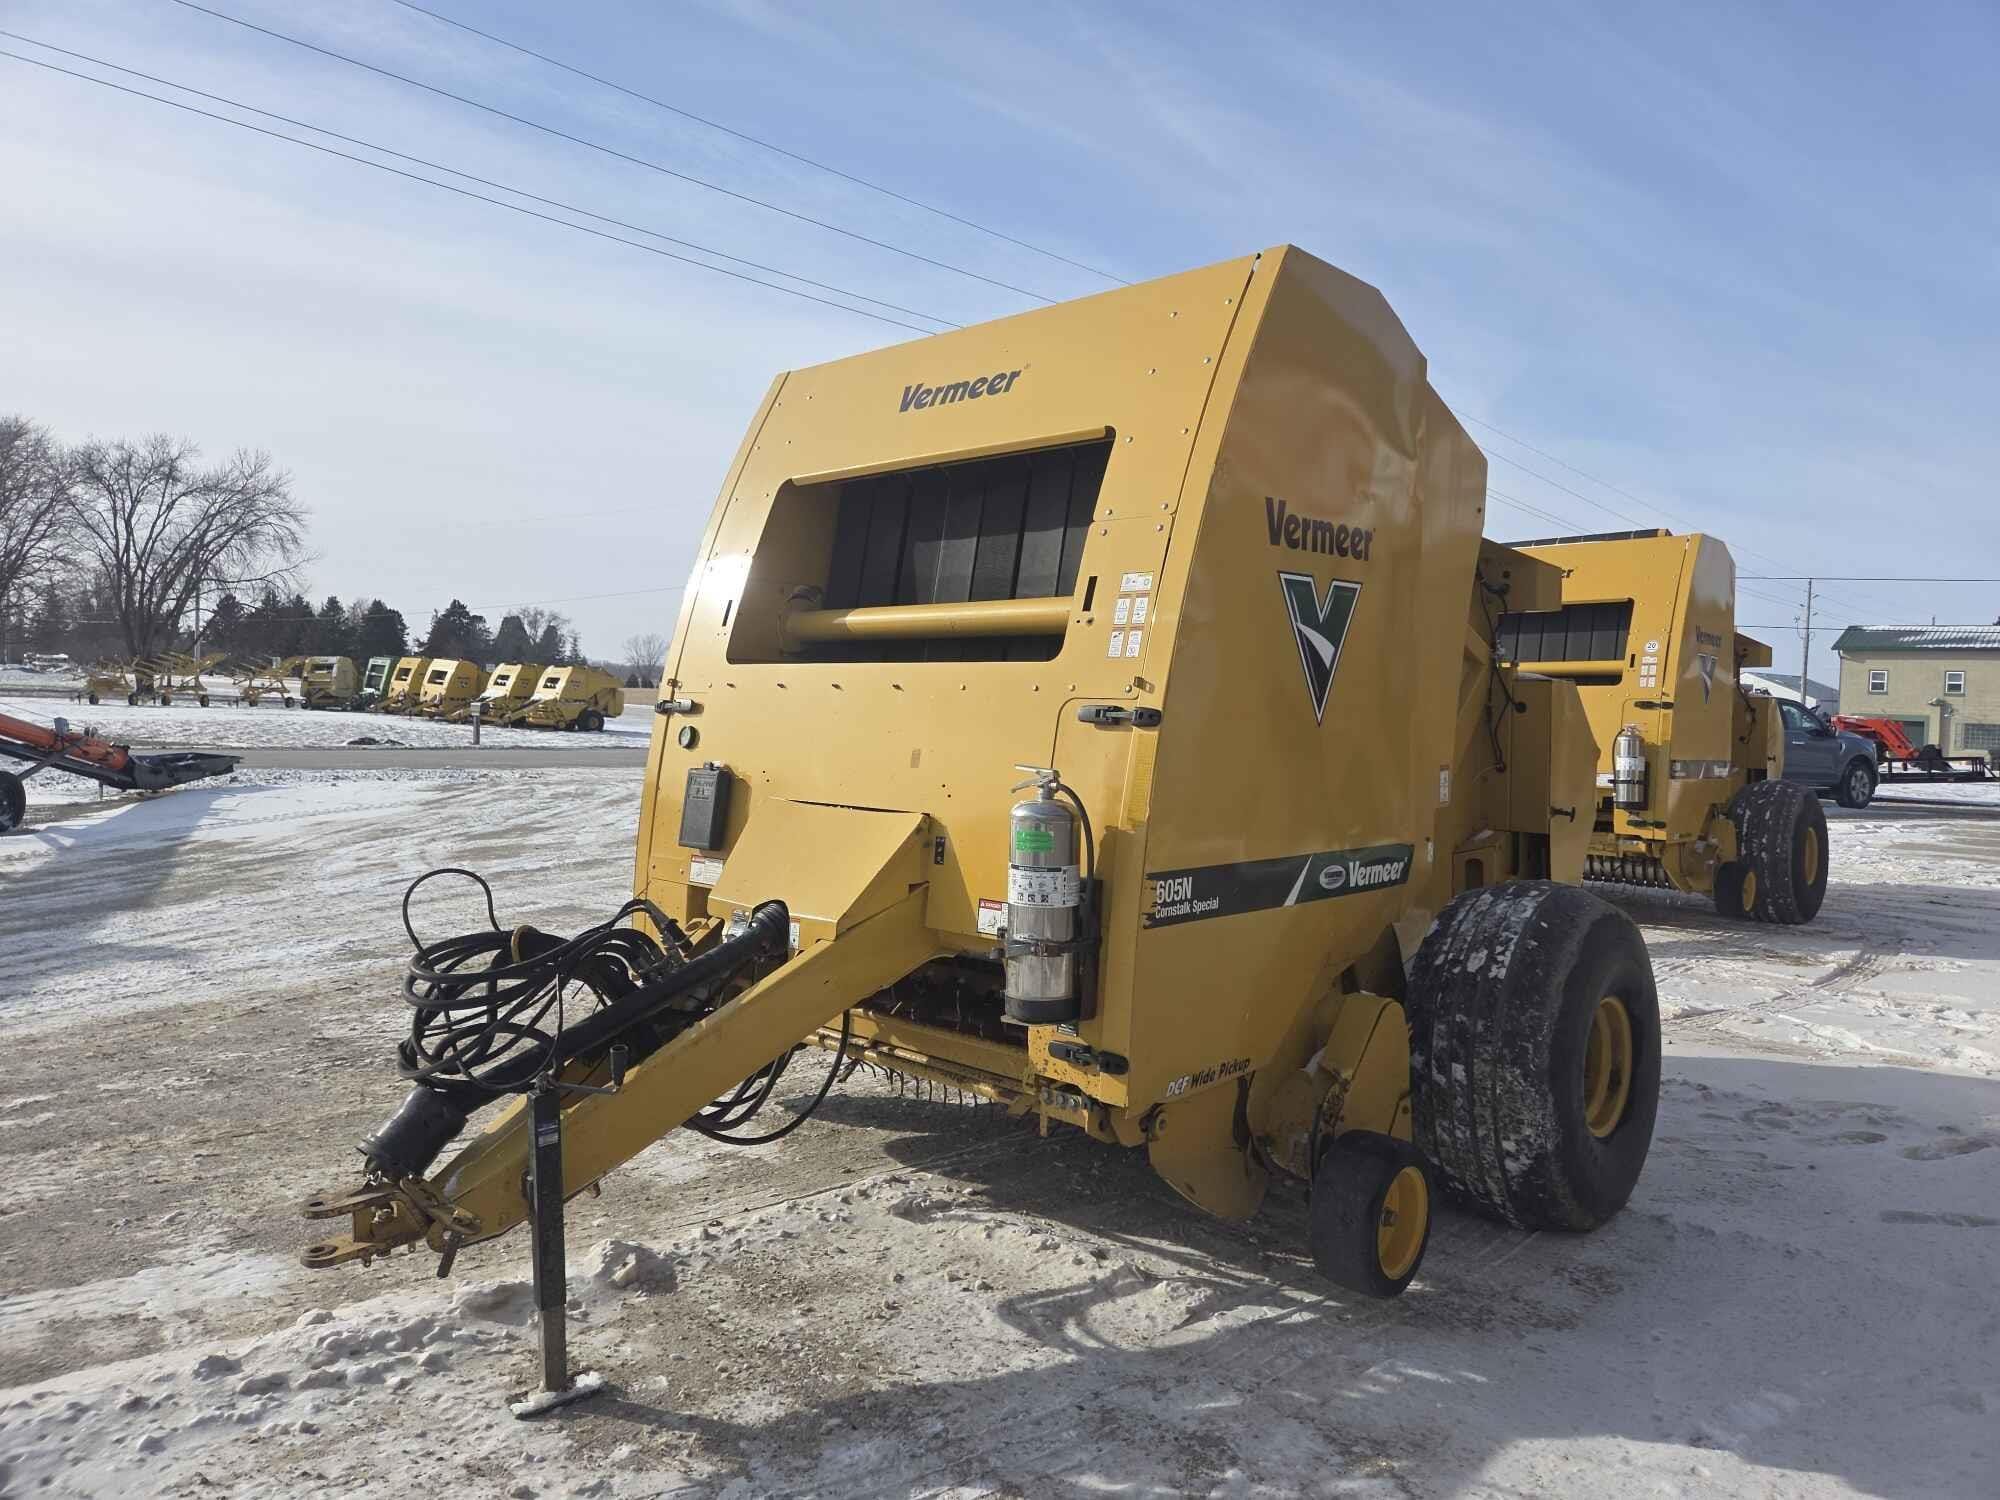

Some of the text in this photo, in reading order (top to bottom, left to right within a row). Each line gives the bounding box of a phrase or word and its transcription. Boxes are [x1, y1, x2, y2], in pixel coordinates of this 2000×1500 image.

[899, 370, 1022, 413] Vermeer
[1265, 496, 1373, 562] Vermeer
[1348, 861, 1405, 888] Vermeer
[1156, 876, 1193, 904] 605N
[1155, 896, 1219, 919] Cornstalk Special
[1190, 1067, 1216, 1089] Wide
[1218, 1058, 1251, 1080] Pickup
